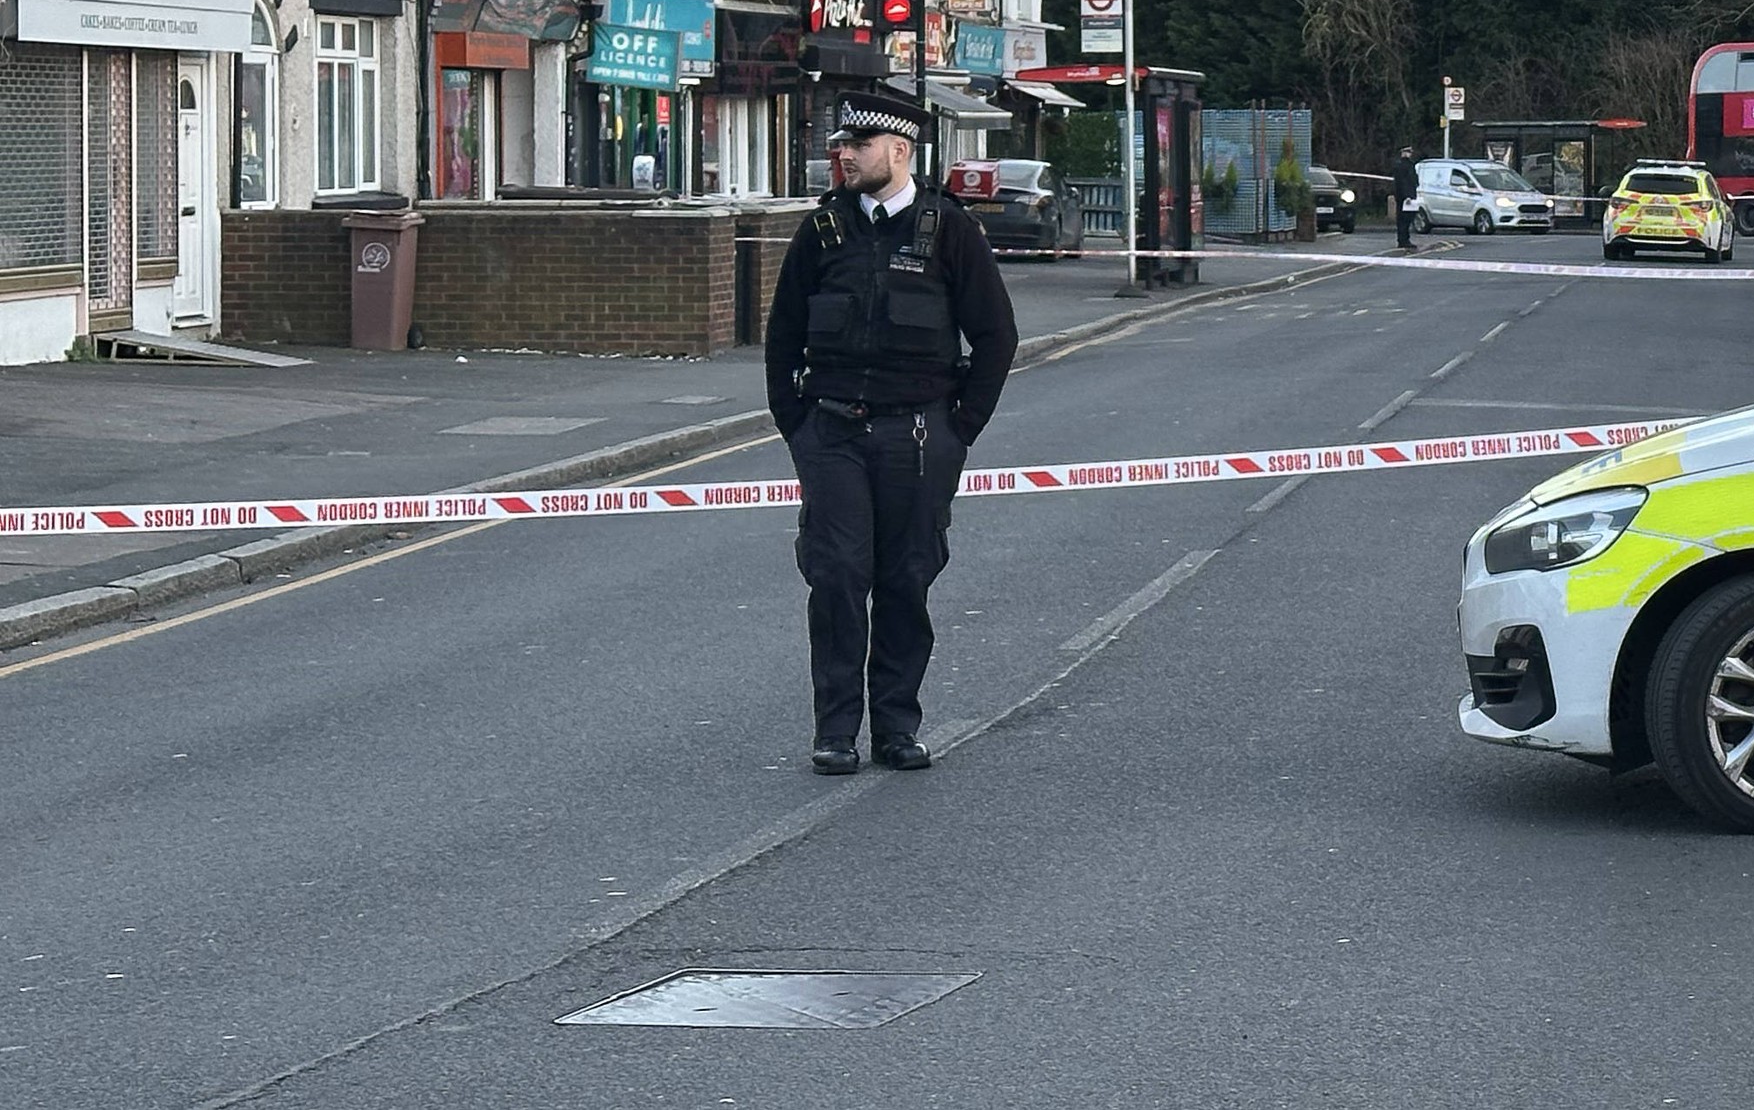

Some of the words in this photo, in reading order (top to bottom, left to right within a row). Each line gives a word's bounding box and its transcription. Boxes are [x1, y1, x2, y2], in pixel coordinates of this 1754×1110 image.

[612, 32, 658, 53] OFF
[601, 50, 666, 68] LICENCE
[1414, 443, 1468, 461] CORDON
[1473, 439, 1512, 457] INNER
[1516, 434, 1560, 452] POLICE
[1268, 453, 1311, 471] CROSS
[1317, 450, 1342, 469] NOT
[1348, 448, 1364, 465] DO
[1068, 467, 1122, 485] CORDON
[1129, 464, 1168, 481] INNER
[1174, 460, 1220, 478] POLICE
[966, 474, 992, 492] NOT
[998, 473, 1015, 490] DO
[595, 492, 623, 511] NOT
[629, 491, 647, 509] DO
[704, 487, 760, 505] CORDON
[766, 484, 801, 502] NNER
[317, 502, 377, 522] CORDON
[383, 499, 429, 519] INNER
[435, 498, 487, 517] POLICE
[541, 494, 588, 513] CROSS
[32, 512, 85, 531] POLICE
[144, 509, 194, 528] CROSS
[201, 507, 231, 526] NOT
[238, 506, 257, 525] DO
